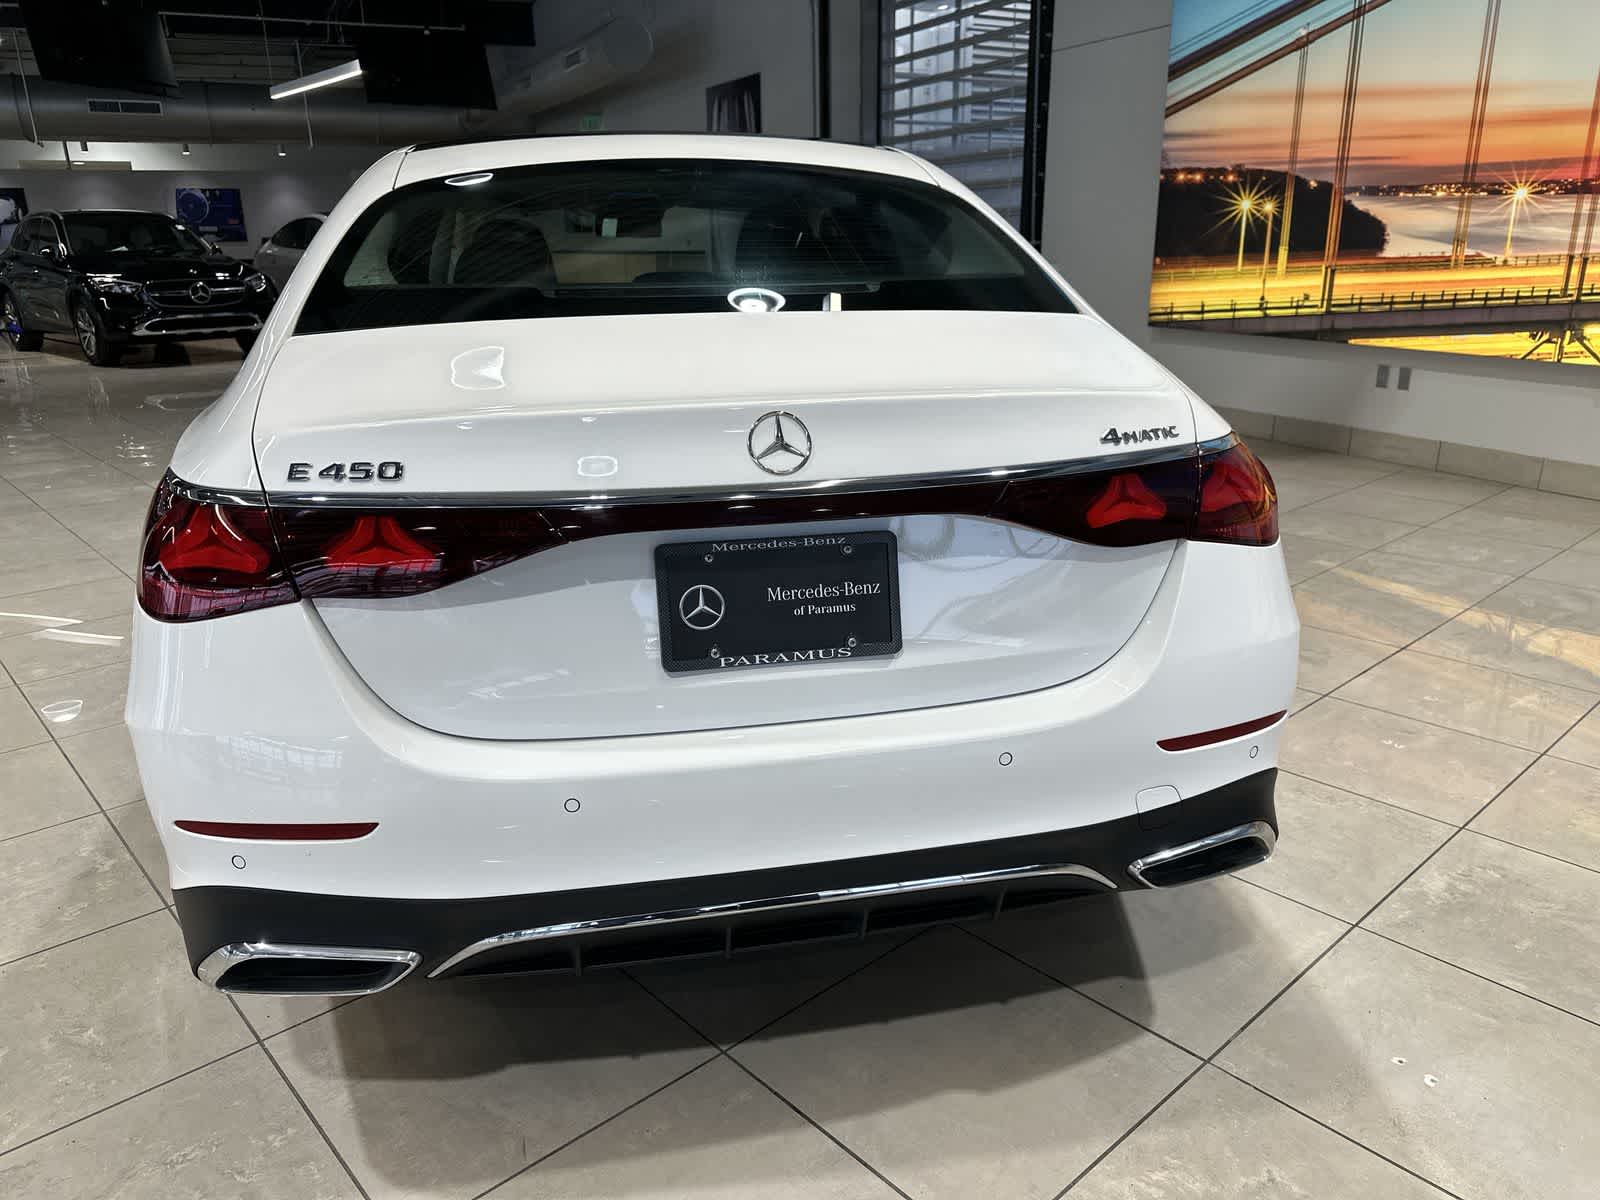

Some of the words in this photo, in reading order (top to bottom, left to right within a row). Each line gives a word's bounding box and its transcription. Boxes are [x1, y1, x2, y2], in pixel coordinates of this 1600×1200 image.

[1100, 425, 1180, 446] 4MATIC
[287, 462, 314, 481] E
[318, 461, 404, 481] 450
[712, 537, 846, 552] Mercedes-Benz
[767, 581, 881, 602] Mercedes-Benz
[794, 605, 805, 616] of
[807, 603, 856, 615] Paramus
[719, 647, 852, 667] PARAMUS
